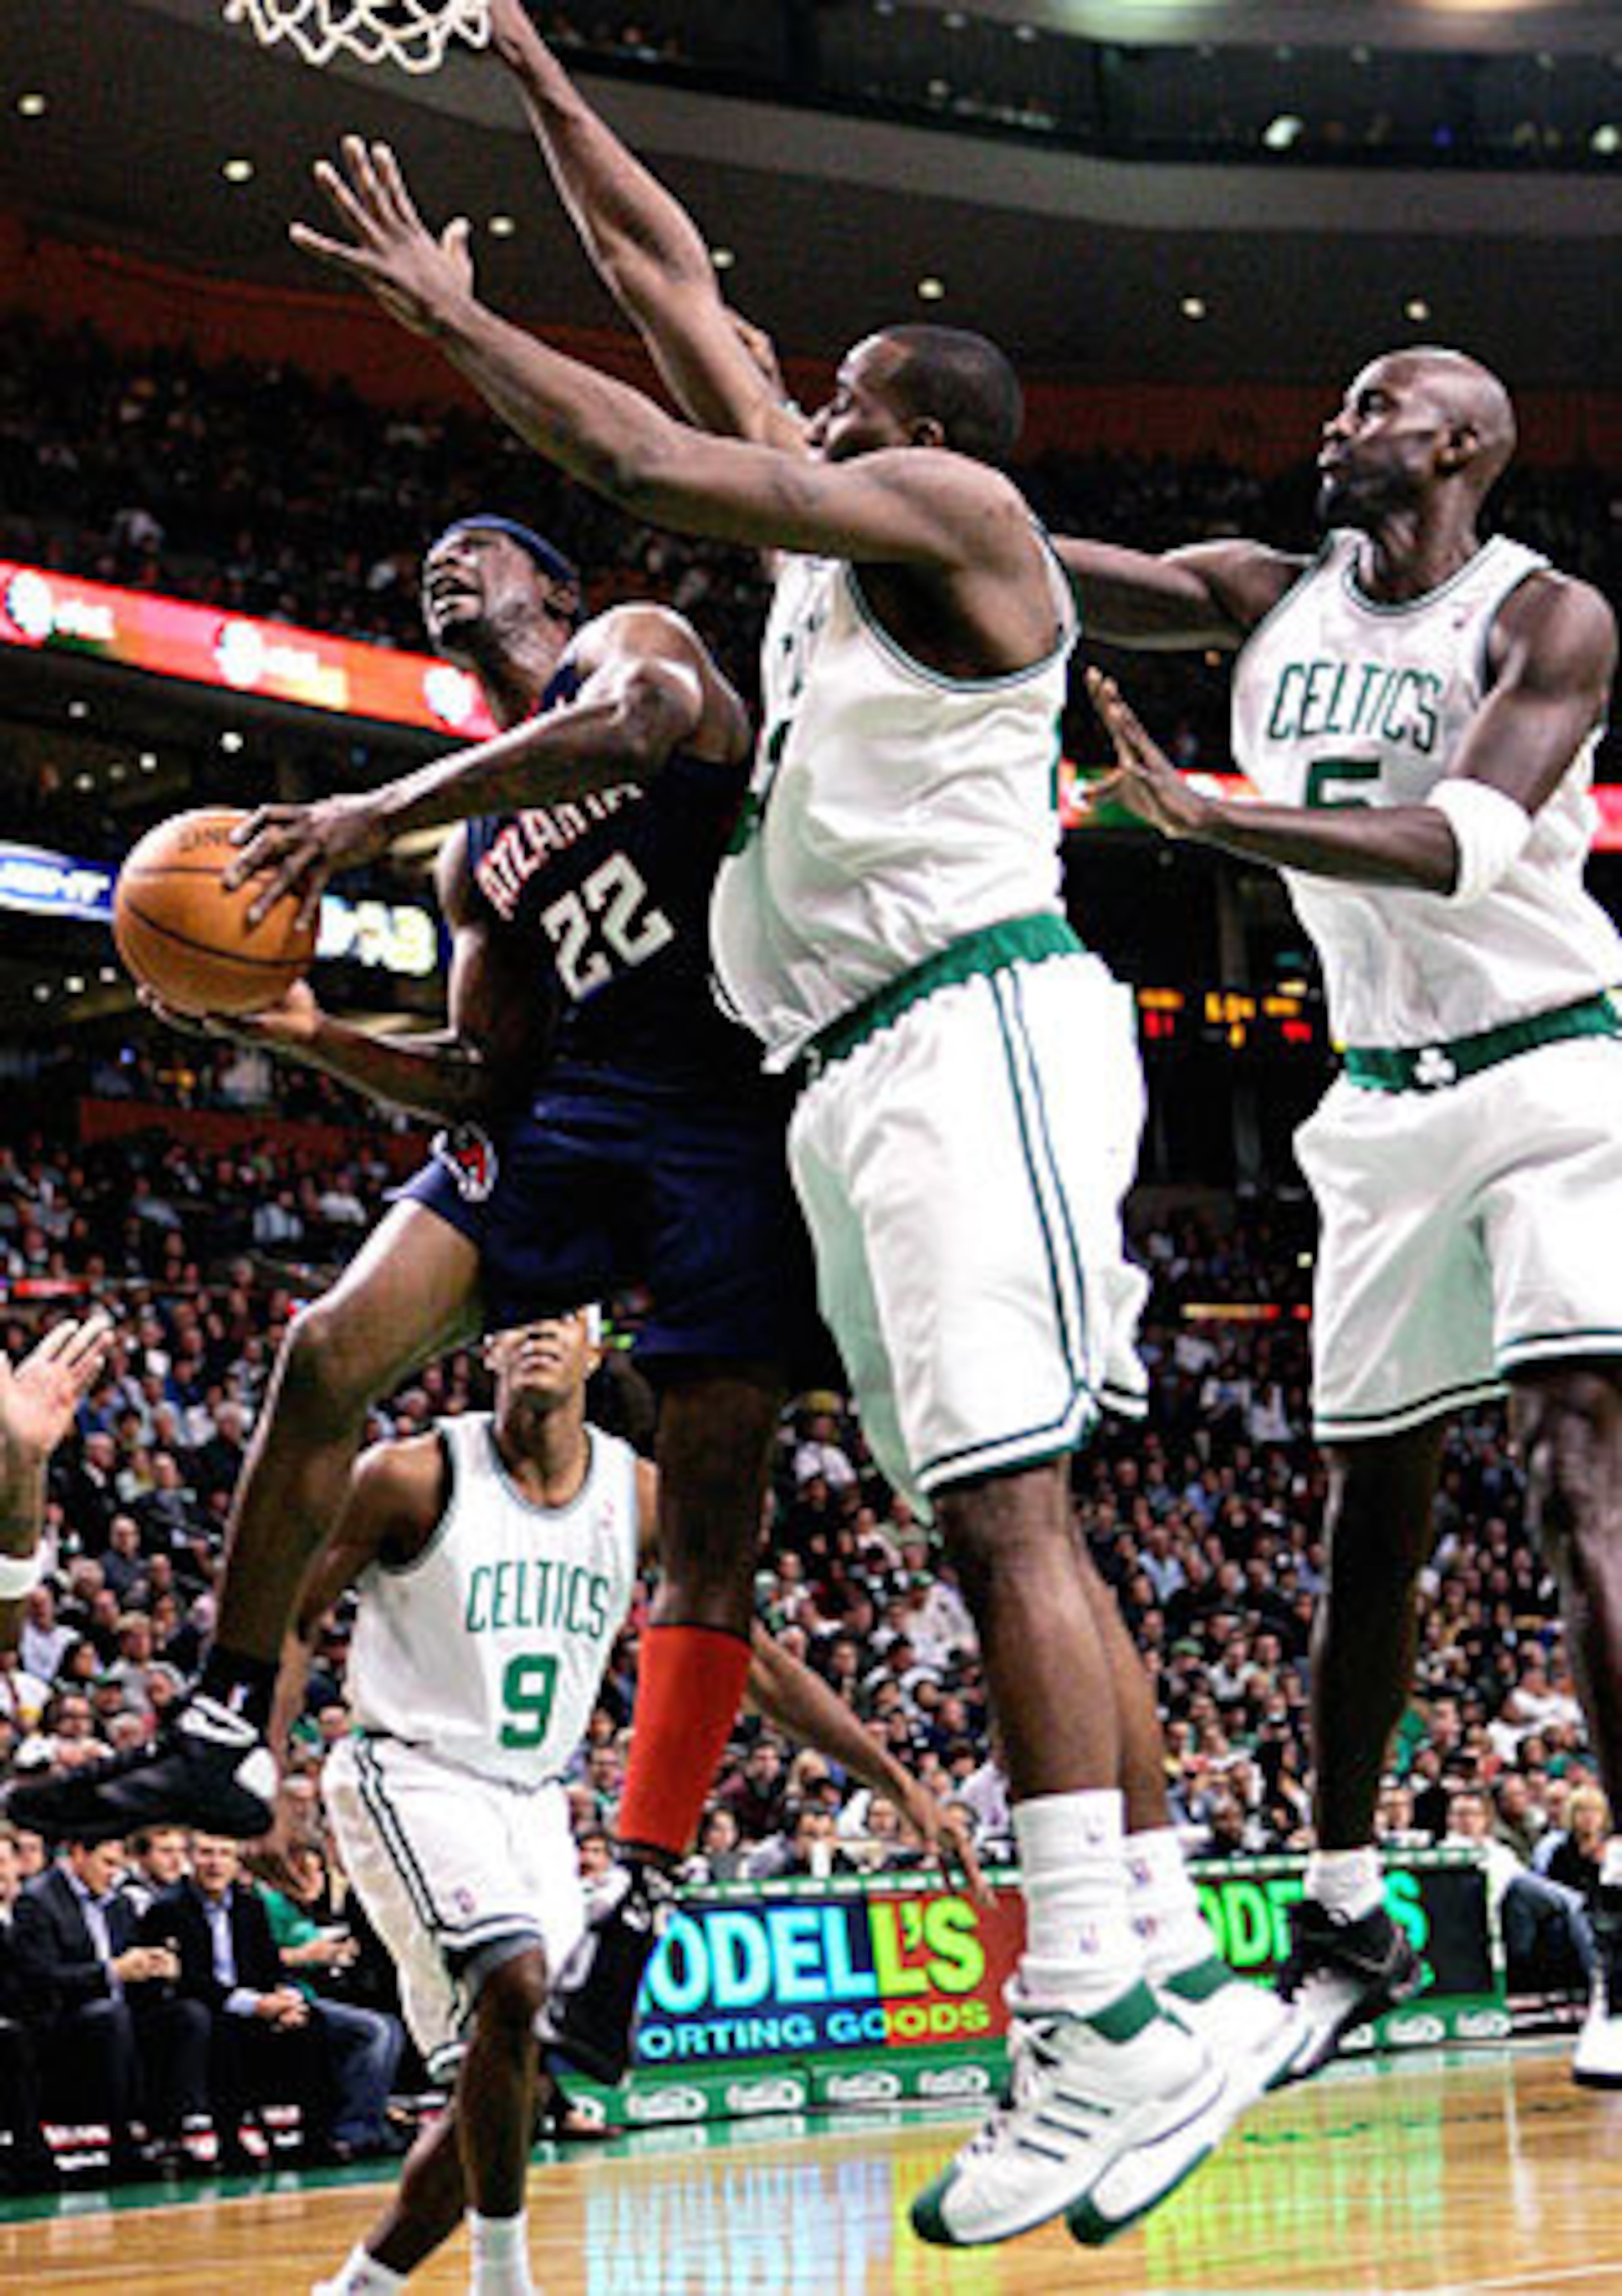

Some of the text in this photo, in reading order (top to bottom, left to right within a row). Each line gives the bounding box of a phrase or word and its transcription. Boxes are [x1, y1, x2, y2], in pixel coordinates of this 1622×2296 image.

[1268, 663, 1441, 753] CELTICS
[541, 849, 675, 1002] 22
[466, 1561, 609, 1641] CELTICS
[499, 1653, 559, 1749] 9
[637, 1896, 985, 2014] ODELL'S
[637, 1999, 989, 2059] ORTING GOODS
